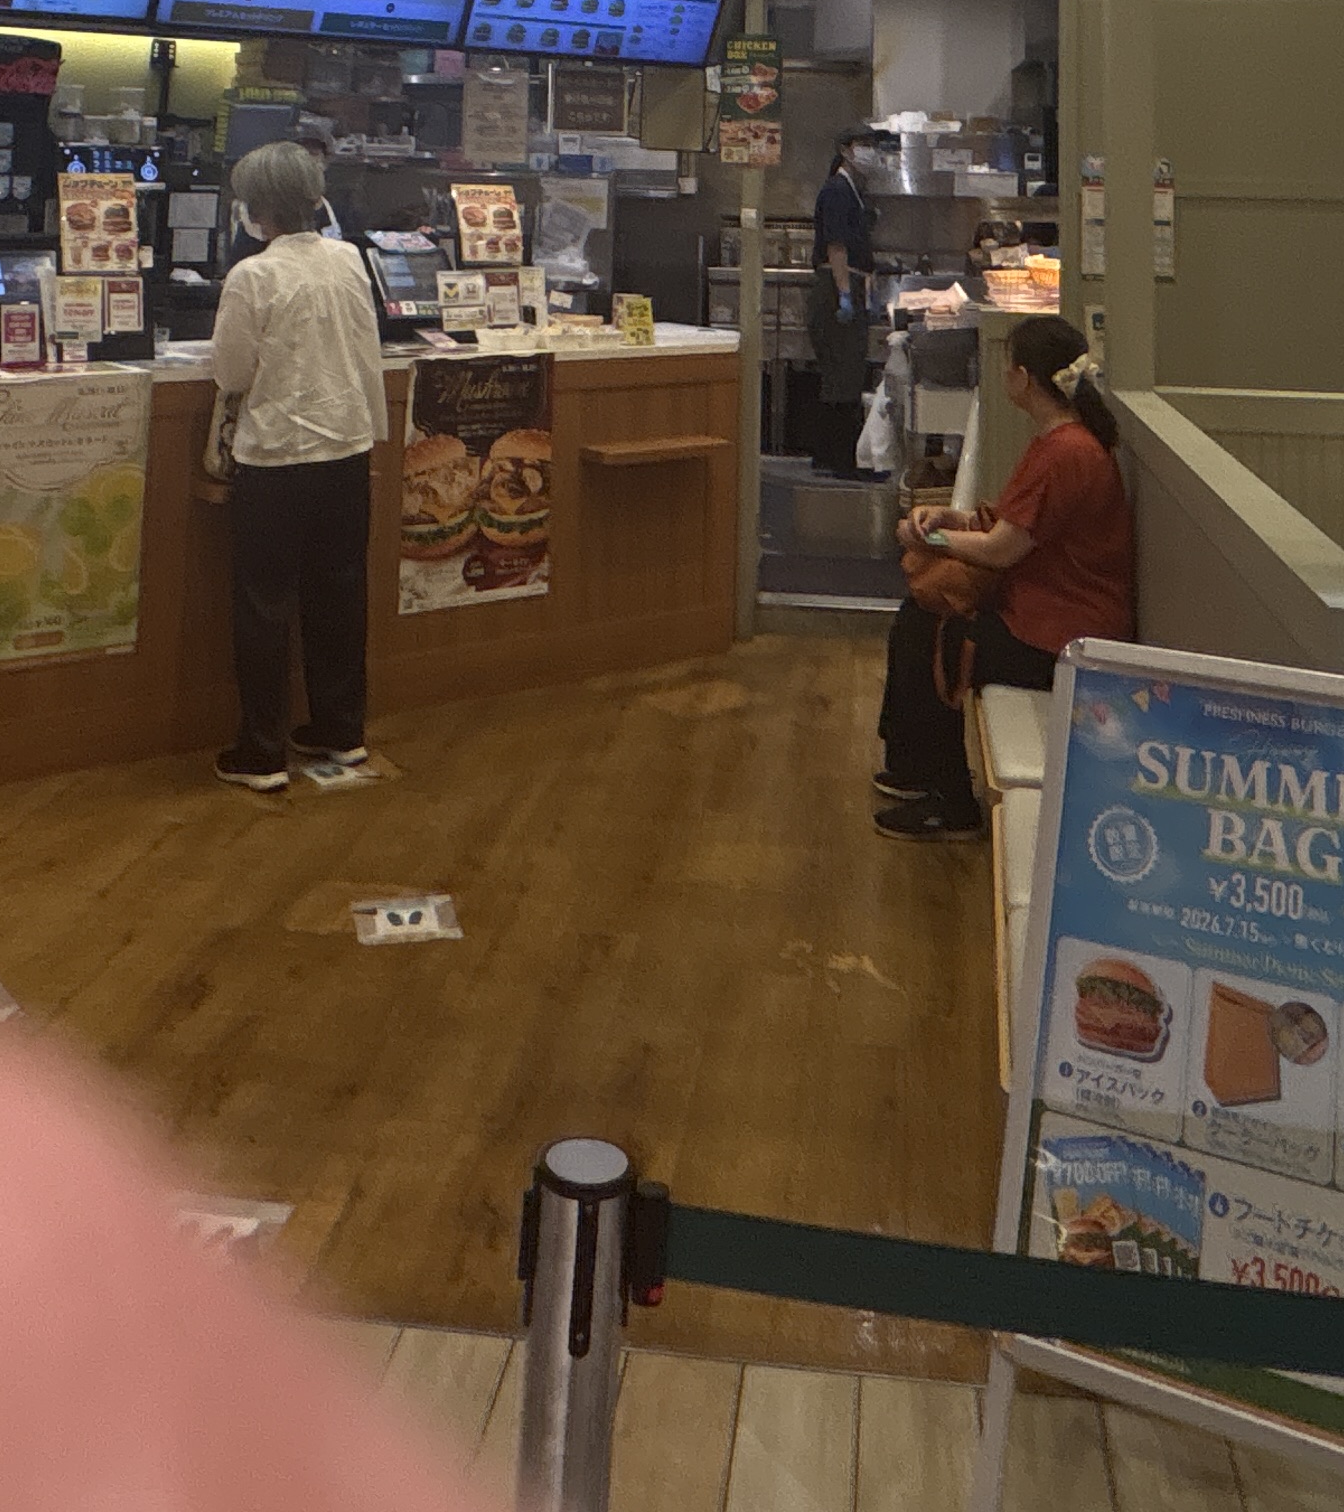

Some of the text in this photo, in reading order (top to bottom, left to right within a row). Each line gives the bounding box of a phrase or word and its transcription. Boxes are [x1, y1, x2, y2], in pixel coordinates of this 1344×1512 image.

[726, 40, 777, 51] CHICKEN
[1202, 702, 1286, 729] FRESHNESS
[1206, 807, 1344, 882] BAG
